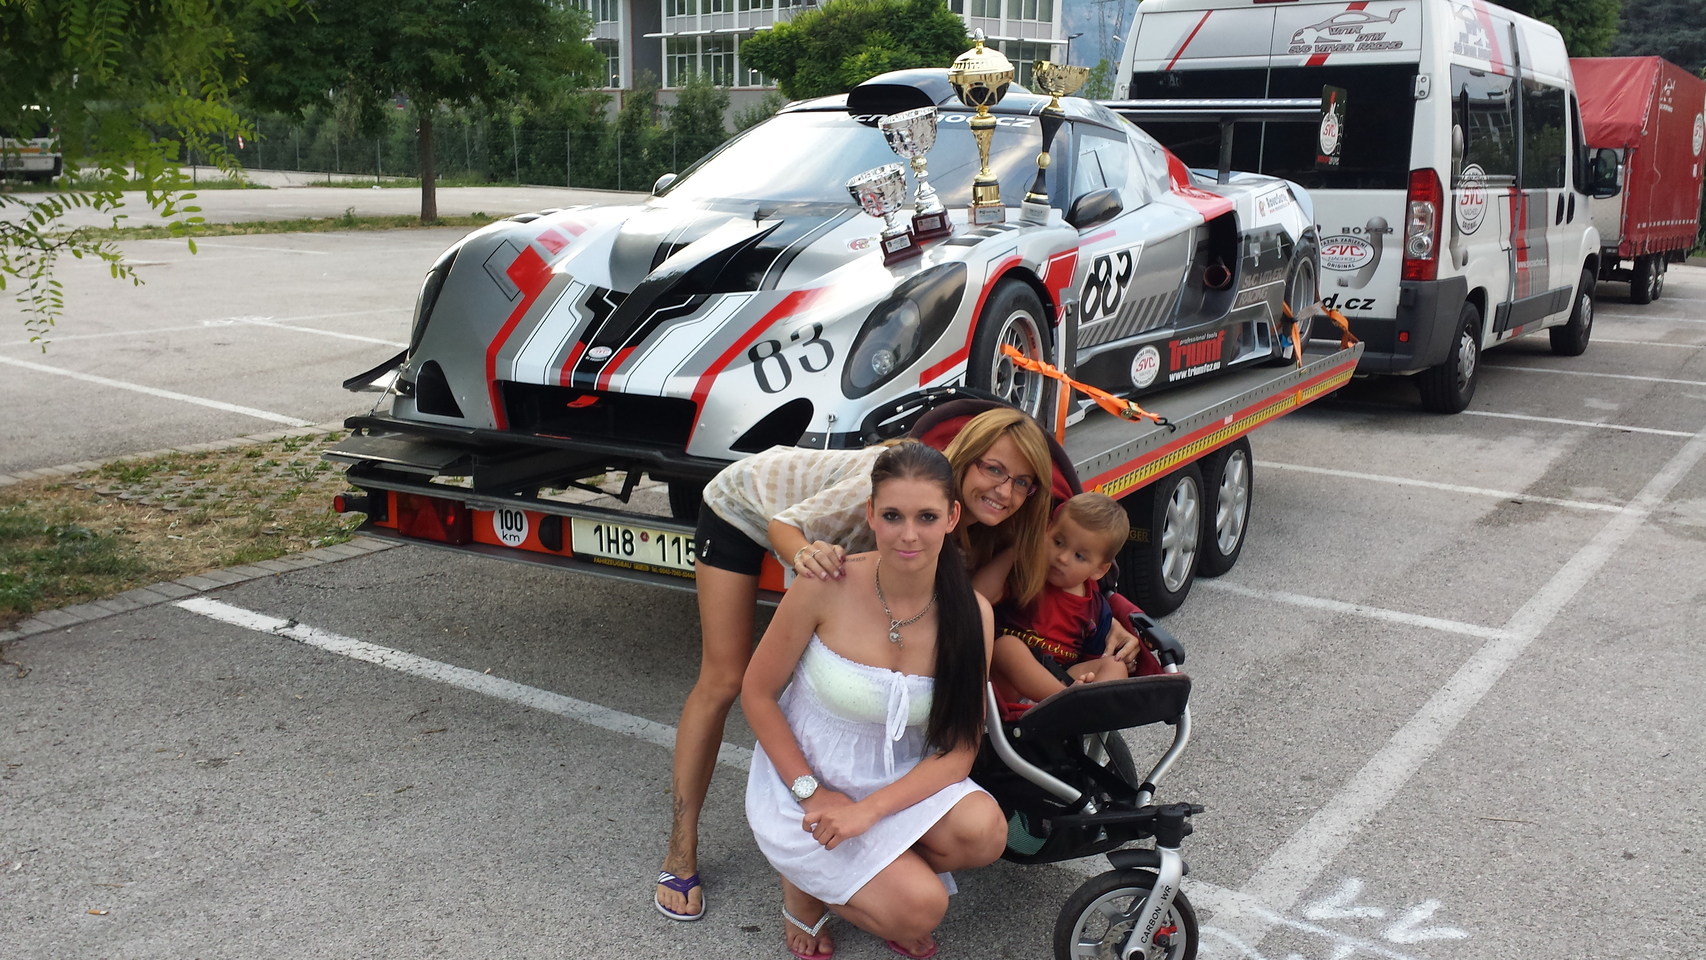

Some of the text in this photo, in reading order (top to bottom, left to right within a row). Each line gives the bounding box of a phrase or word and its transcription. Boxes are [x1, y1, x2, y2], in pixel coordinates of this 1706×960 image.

[1289, 44, 1312, 54] SVC
[1356, 41, 1403, 51] RACING
[1460, 187, 1482, 206] SVC
[1341, 227, 1394, 235] BOXER
[1321, 245, 1365, 257] SVC
[1080, 249, 1133, 324] 83
[1239, 287, 1269, 305] RACING
[1179, 333, 1206, 346] professional
[747, 321, 835, 394] 83
[1169, 329, 1226, 371] Triumf
[1135, 356, 1156, 372] SVC
[499, 509, 524, 532] 100
[502, 531, 520, 542] km
[594, 524, 695, 566] 1H8 115
[1140, 906, 1162, 944] CARBON
[1161, 885, 1172, 901] WR
